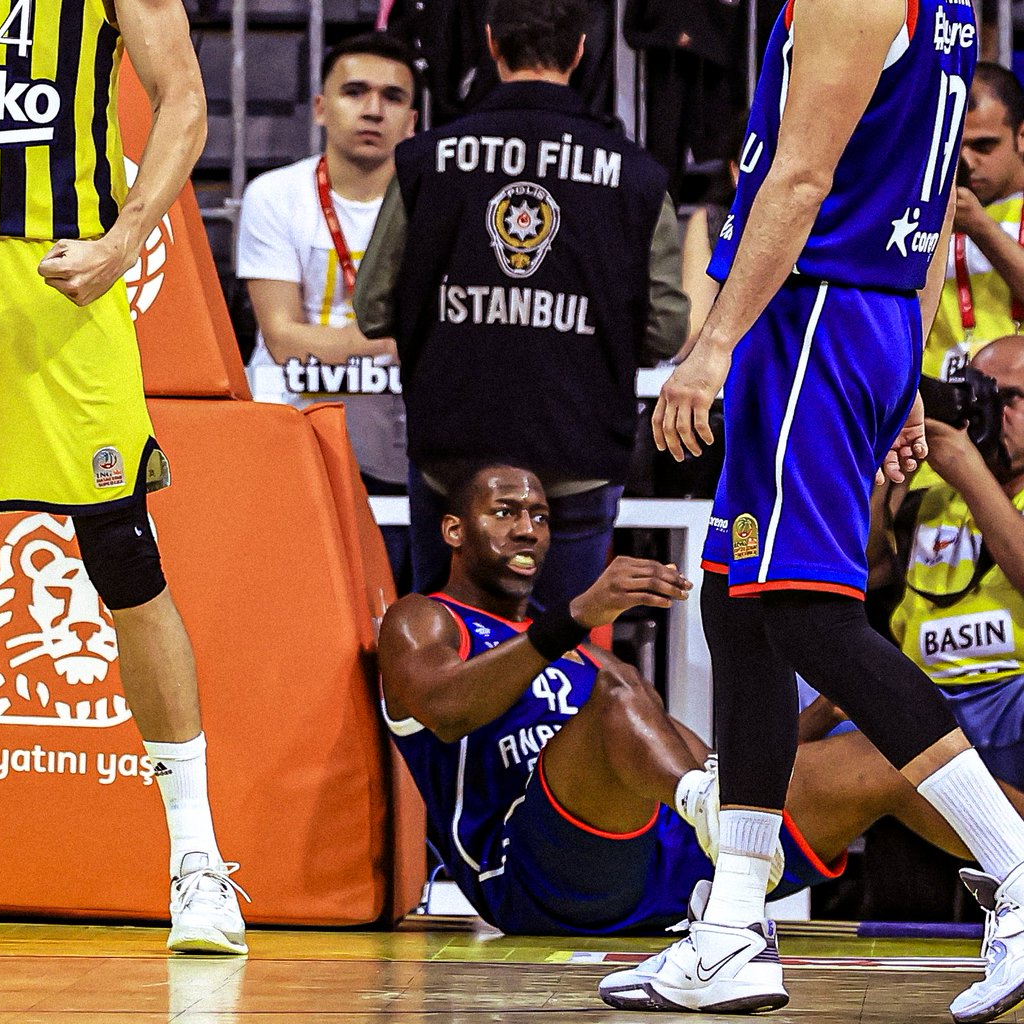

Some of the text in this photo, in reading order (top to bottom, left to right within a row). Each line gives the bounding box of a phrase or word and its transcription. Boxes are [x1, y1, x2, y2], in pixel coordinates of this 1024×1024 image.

[435, 132, 622, 189] FOTO FİLM
[438, 274, 597, 336] İSTANBUL
[924, 619, 1007, 657] BASIN
[531, 666, 579, 715] 42
